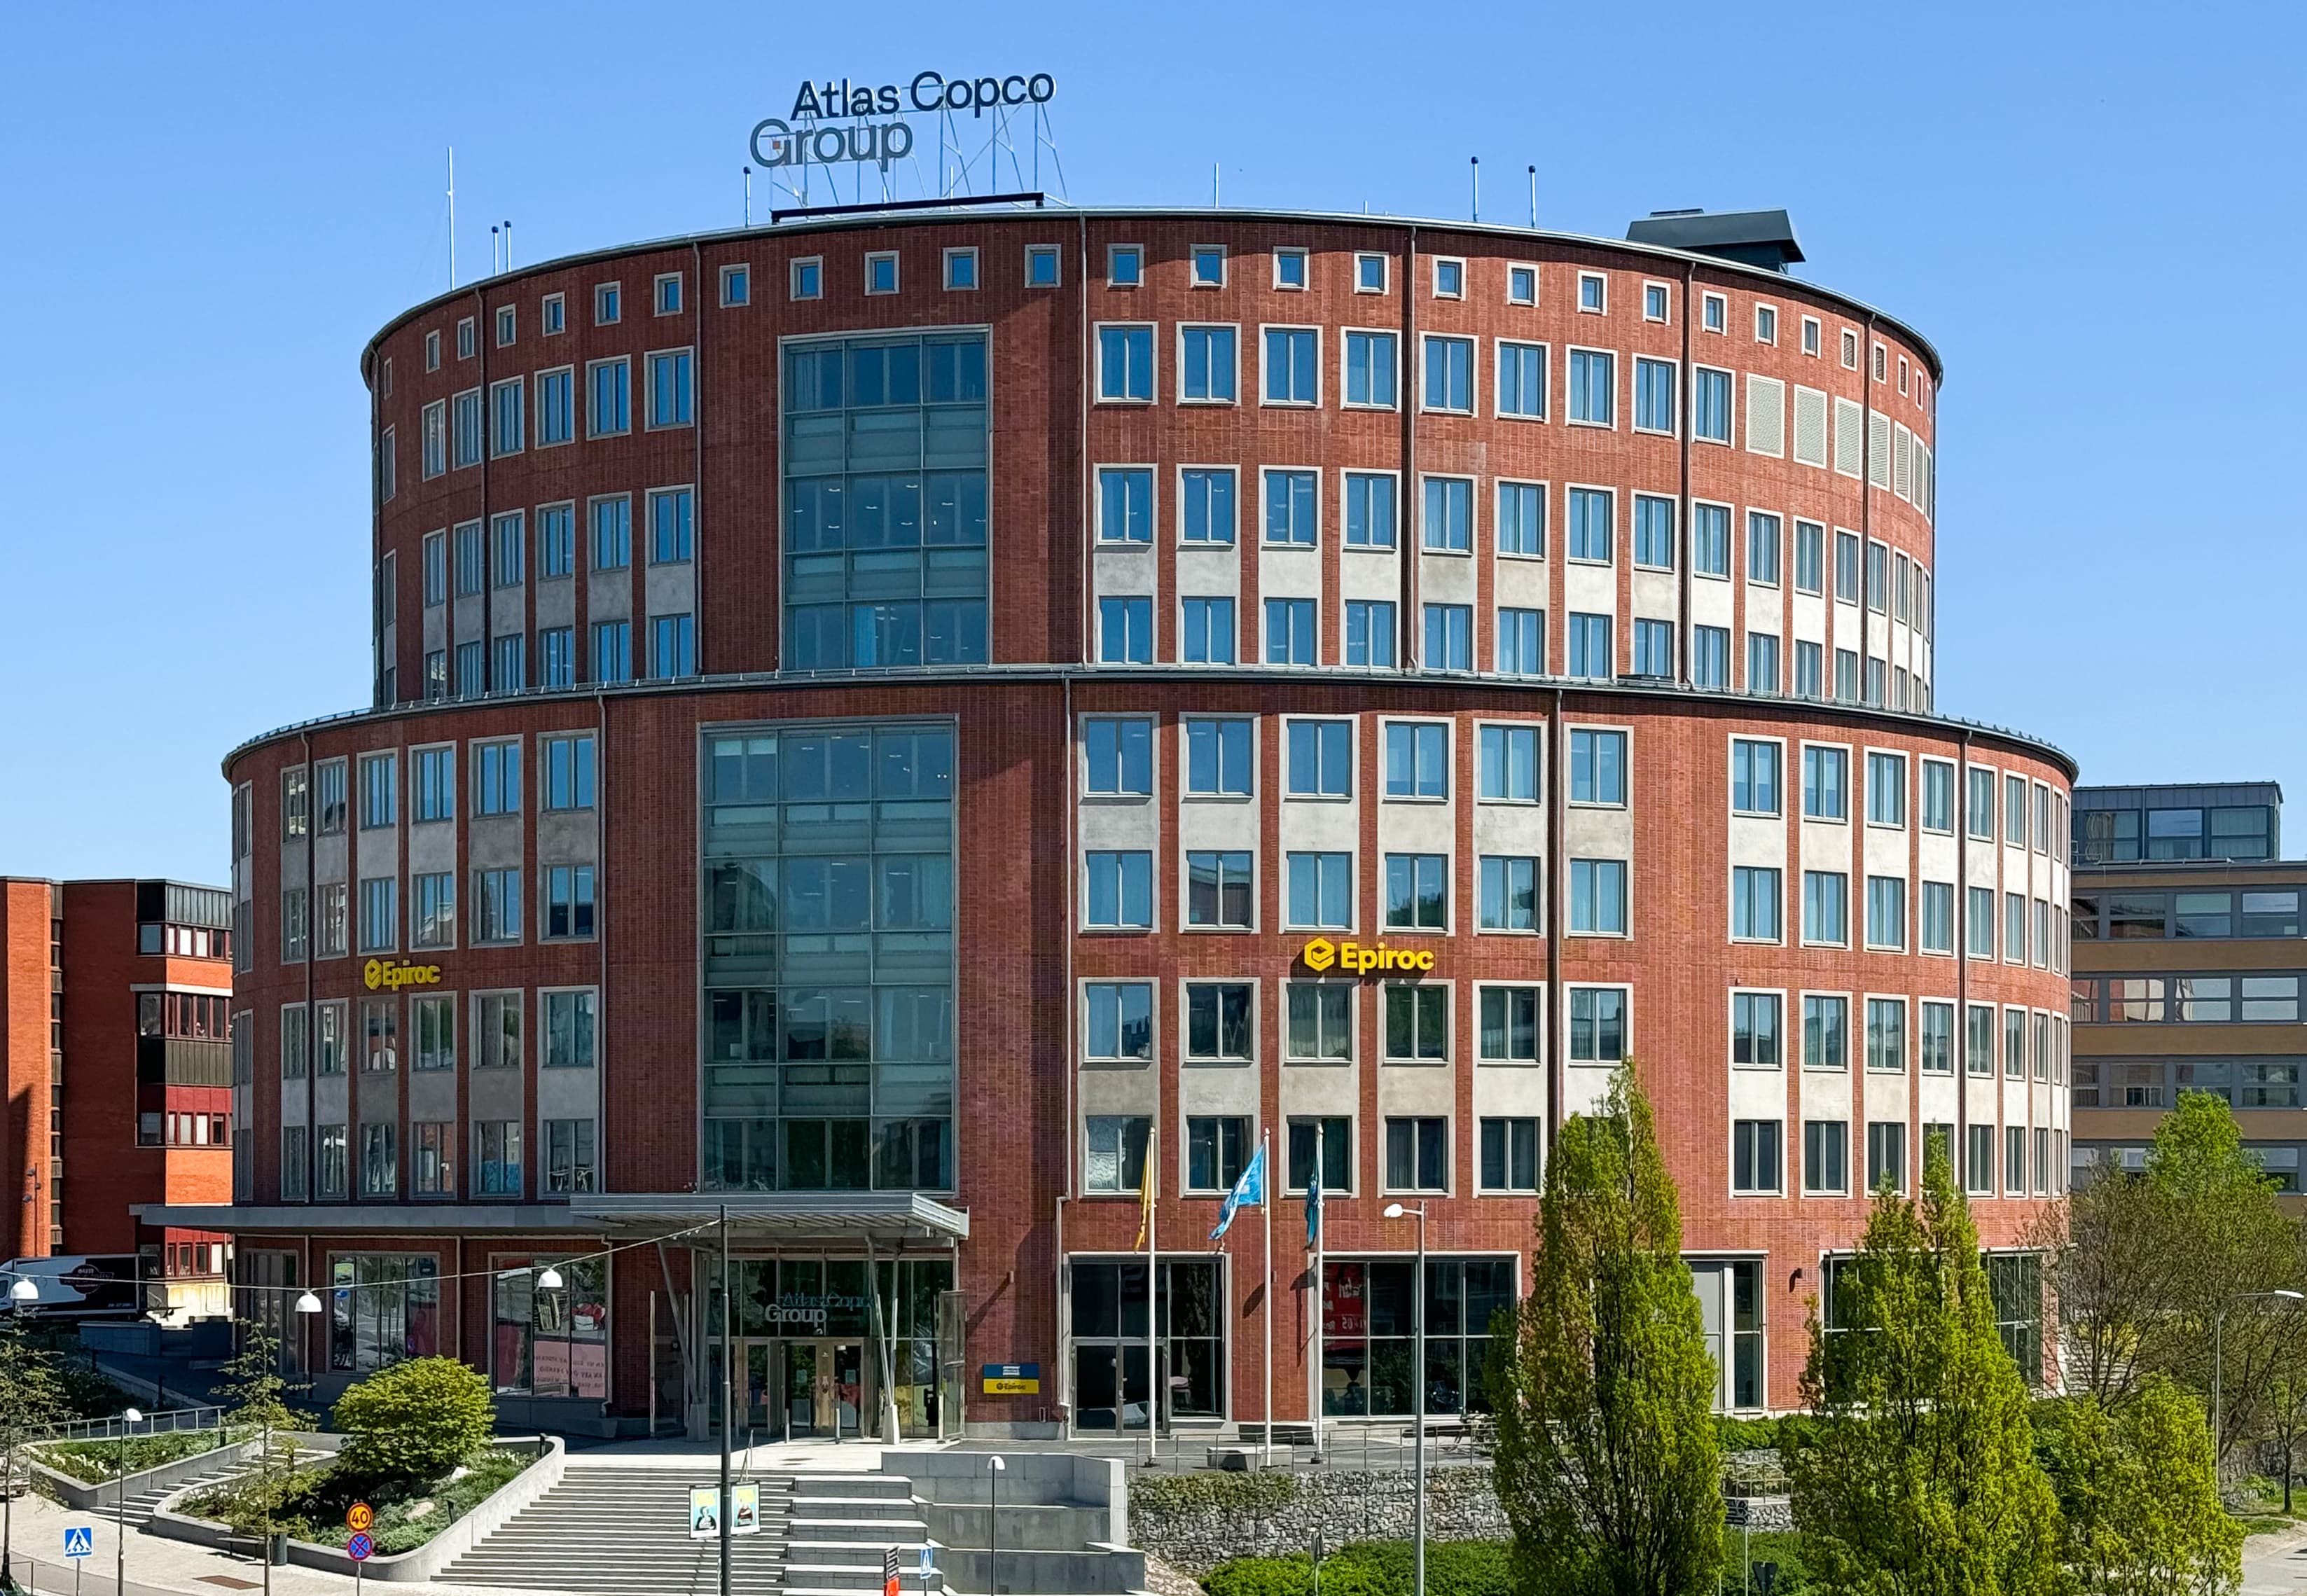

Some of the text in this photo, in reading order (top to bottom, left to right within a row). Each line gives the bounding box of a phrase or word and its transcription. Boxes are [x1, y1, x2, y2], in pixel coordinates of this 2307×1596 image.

[791, 71, 1055, 121] Atlas Copco
[750, 118, 913, 172] Group
[1340, 942, 1434, 975] Epiroc
[382, 959, 441, 991] Epiroc
[765, 1304, 827, 1328] Group
[352, 1511, 368, 1525] 40
